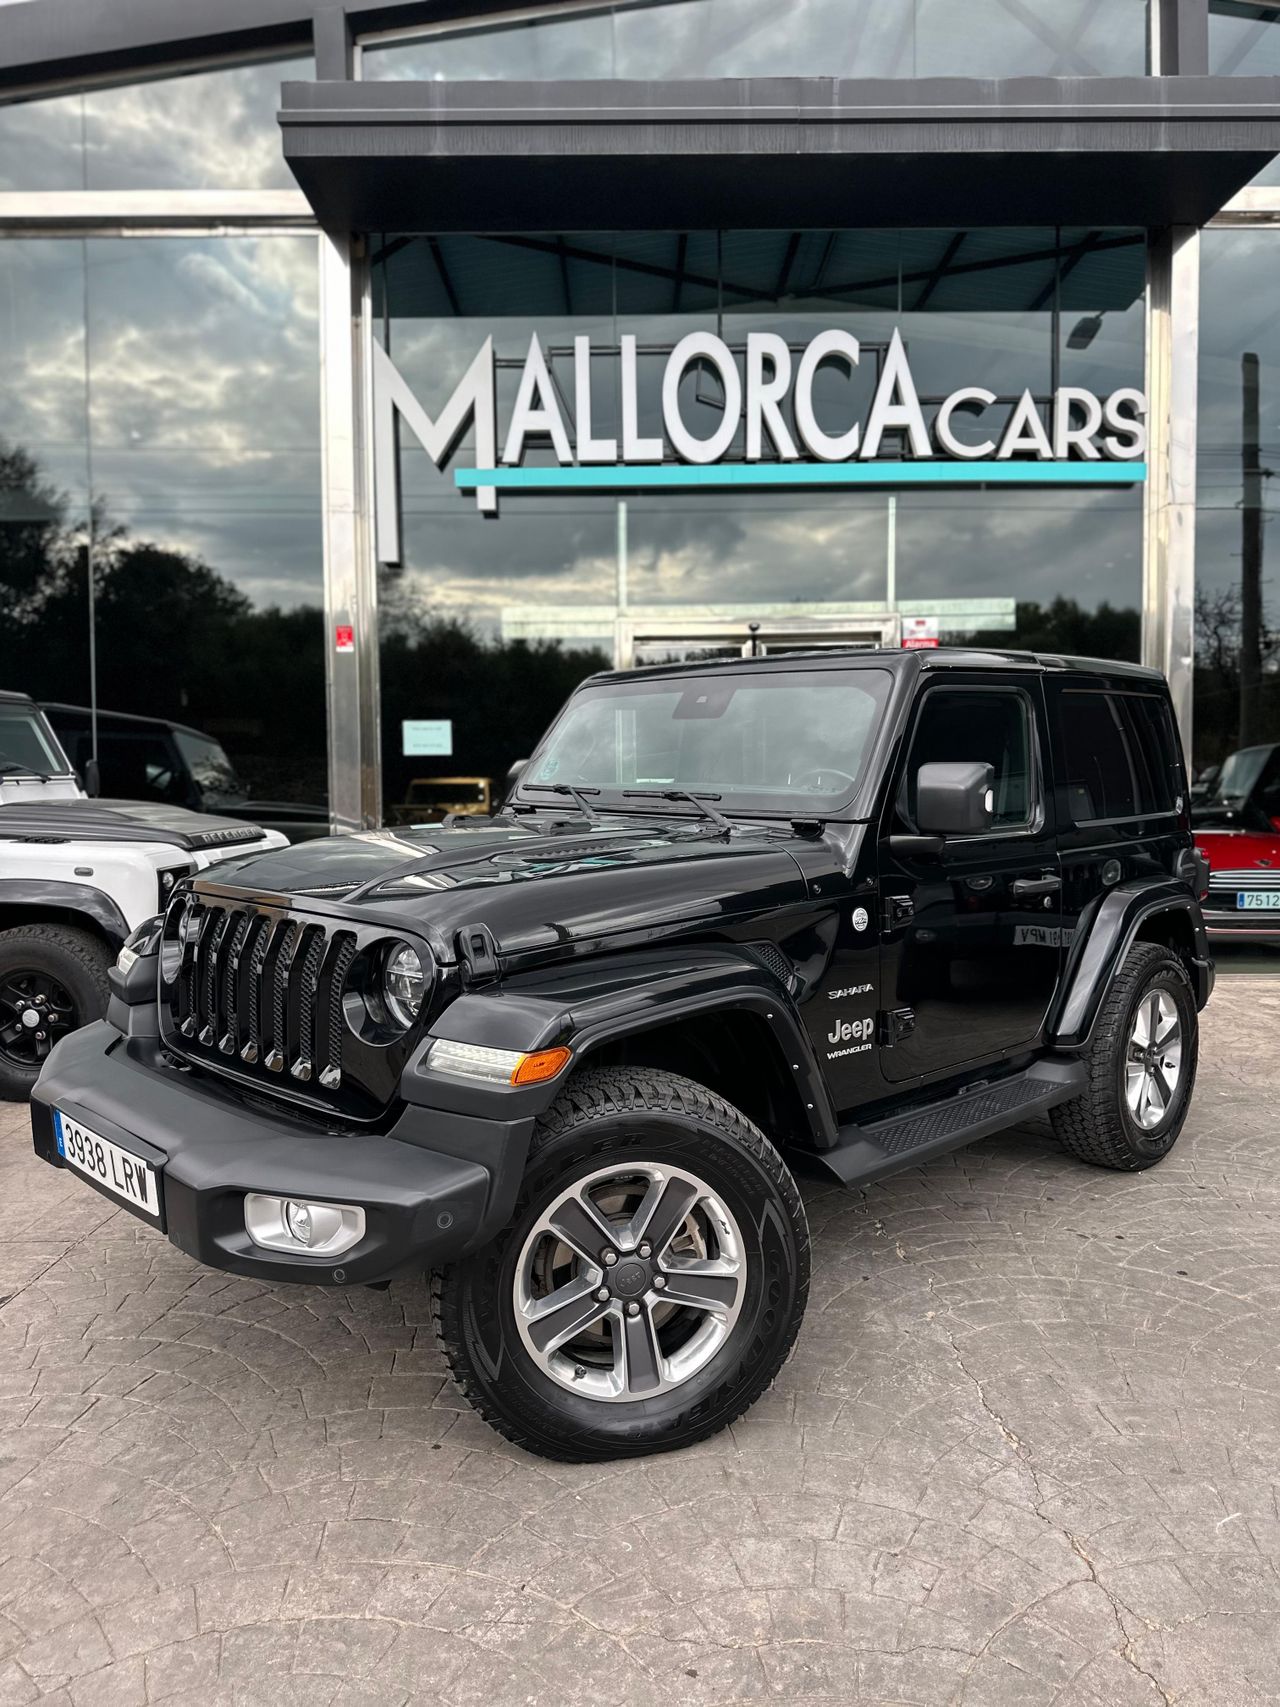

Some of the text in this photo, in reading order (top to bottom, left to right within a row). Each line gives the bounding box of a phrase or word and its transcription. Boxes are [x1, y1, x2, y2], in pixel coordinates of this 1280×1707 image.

[372, 327, 1147, 562] MALLORCA CARS
[1247, 894, 1280, 907] 7512
[828, 983, 874, 1000] SAHARA
[828, 1017, 874, 1044] Jeep
[826, 1043, 872, 1060] WRANGLER
[65, 1123, 107, 1178] 3938
[110, 1149, 148, 1204] LRW
